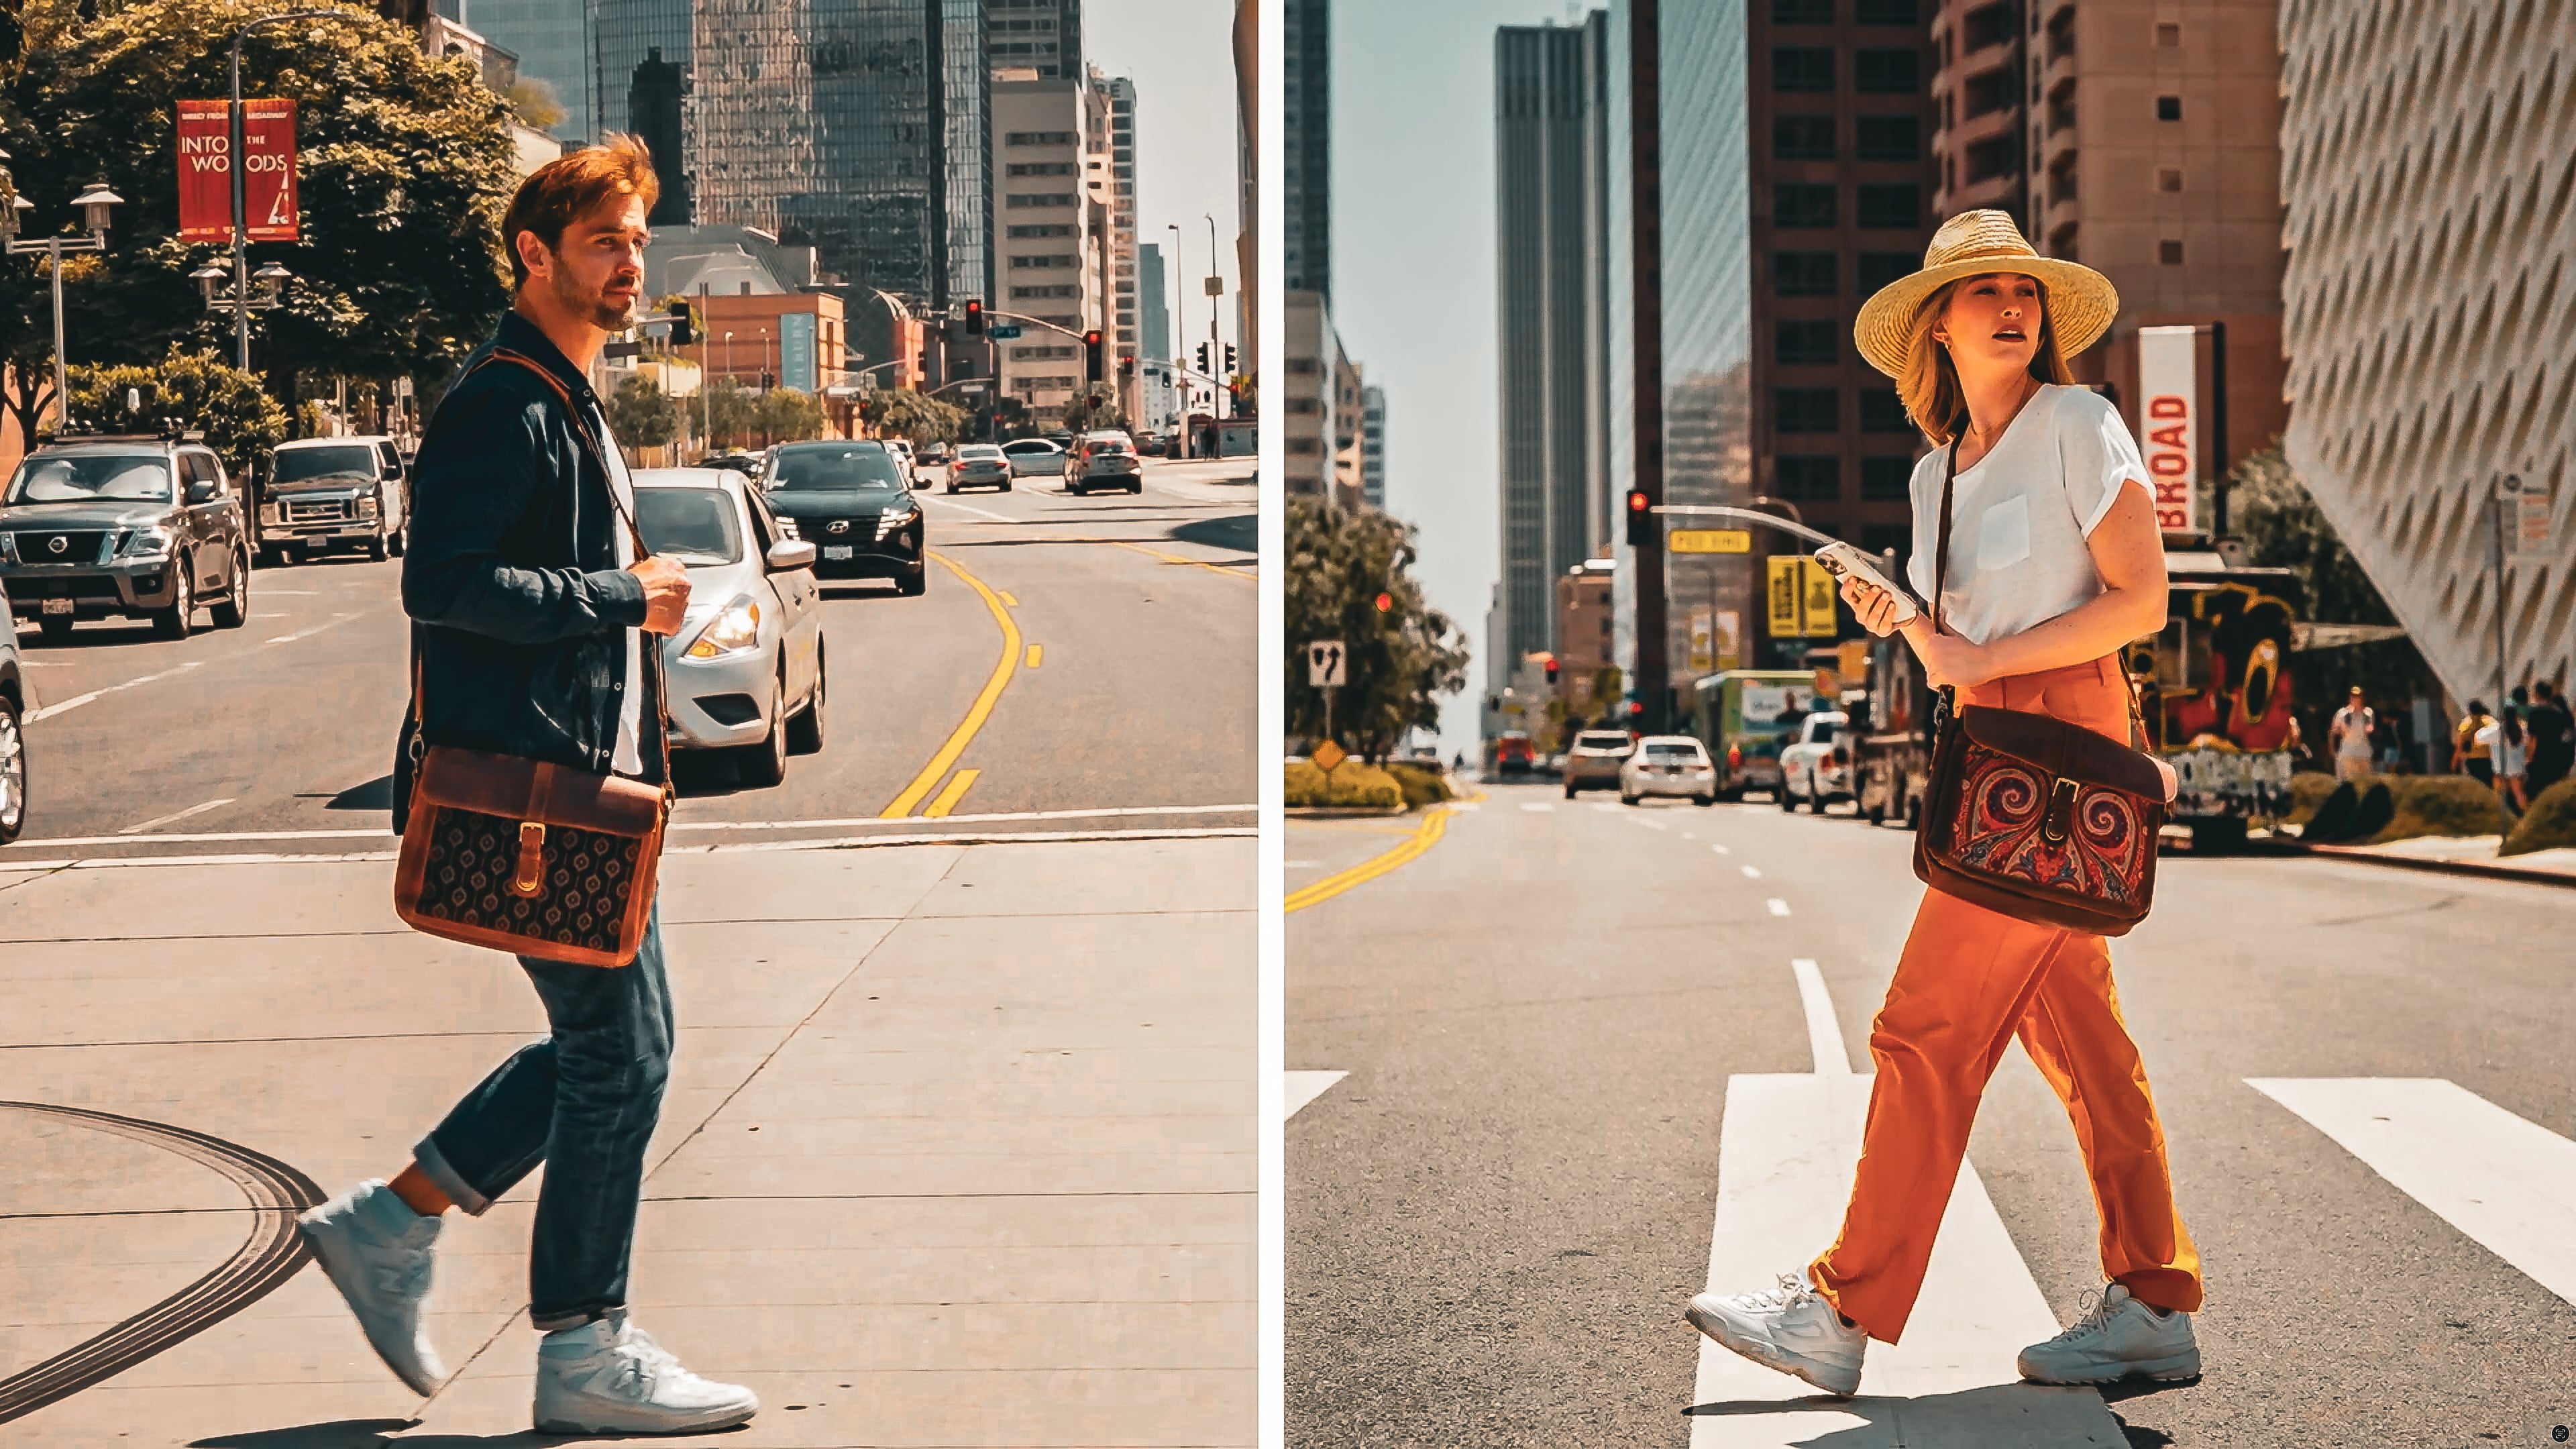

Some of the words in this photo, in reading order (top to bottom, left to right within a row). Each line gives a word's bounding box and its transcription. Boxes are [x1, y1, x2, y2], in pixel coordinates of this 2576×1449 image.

[182, 136, 229, 154] INTO
[246, 136, 265, 144] THE
[2150, 397, 2187, 527] BROAD
